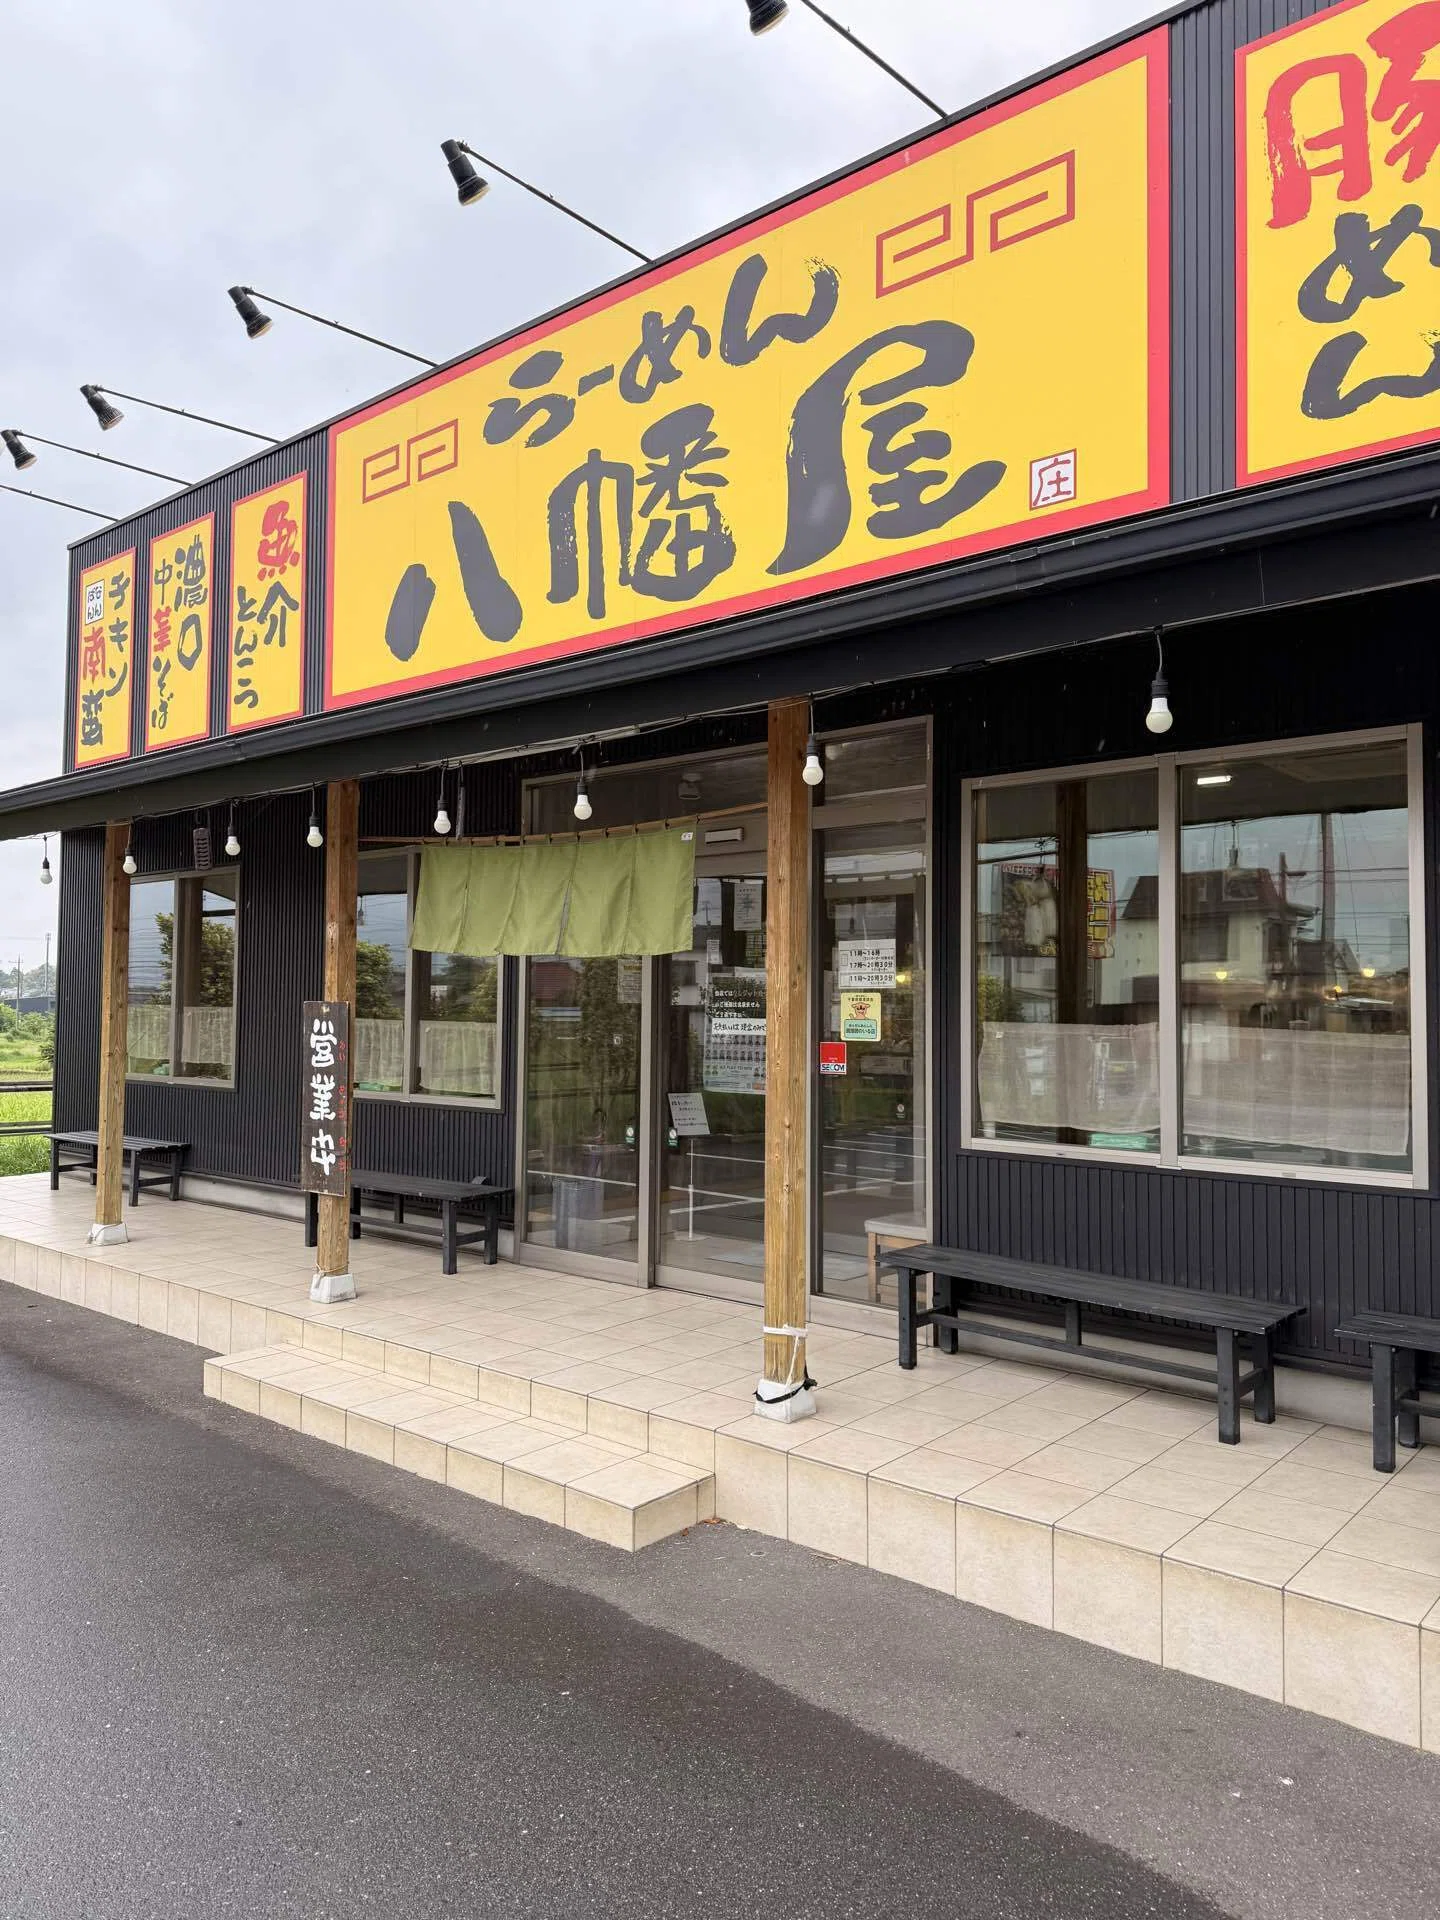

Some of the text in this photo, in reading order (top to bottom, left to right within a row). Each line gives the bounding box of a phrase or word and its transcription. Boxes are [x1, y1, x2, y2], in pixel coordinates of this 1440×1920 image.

[482, 253, 841, 447] らーめん
[384, 320, 1008, 662] 八幡屋
[1032, 457, 1072, 506] 庄
[105, 570, 131, 698] チキン
[152, 558, 174, 730] 中華そば
[233, 585, 259, 709] とんこつ
[256, 500, 300, 648] 魚介
[309, 1018, 338, 1176] 営業中
[821, 1063, 845, 1072] SECOM
